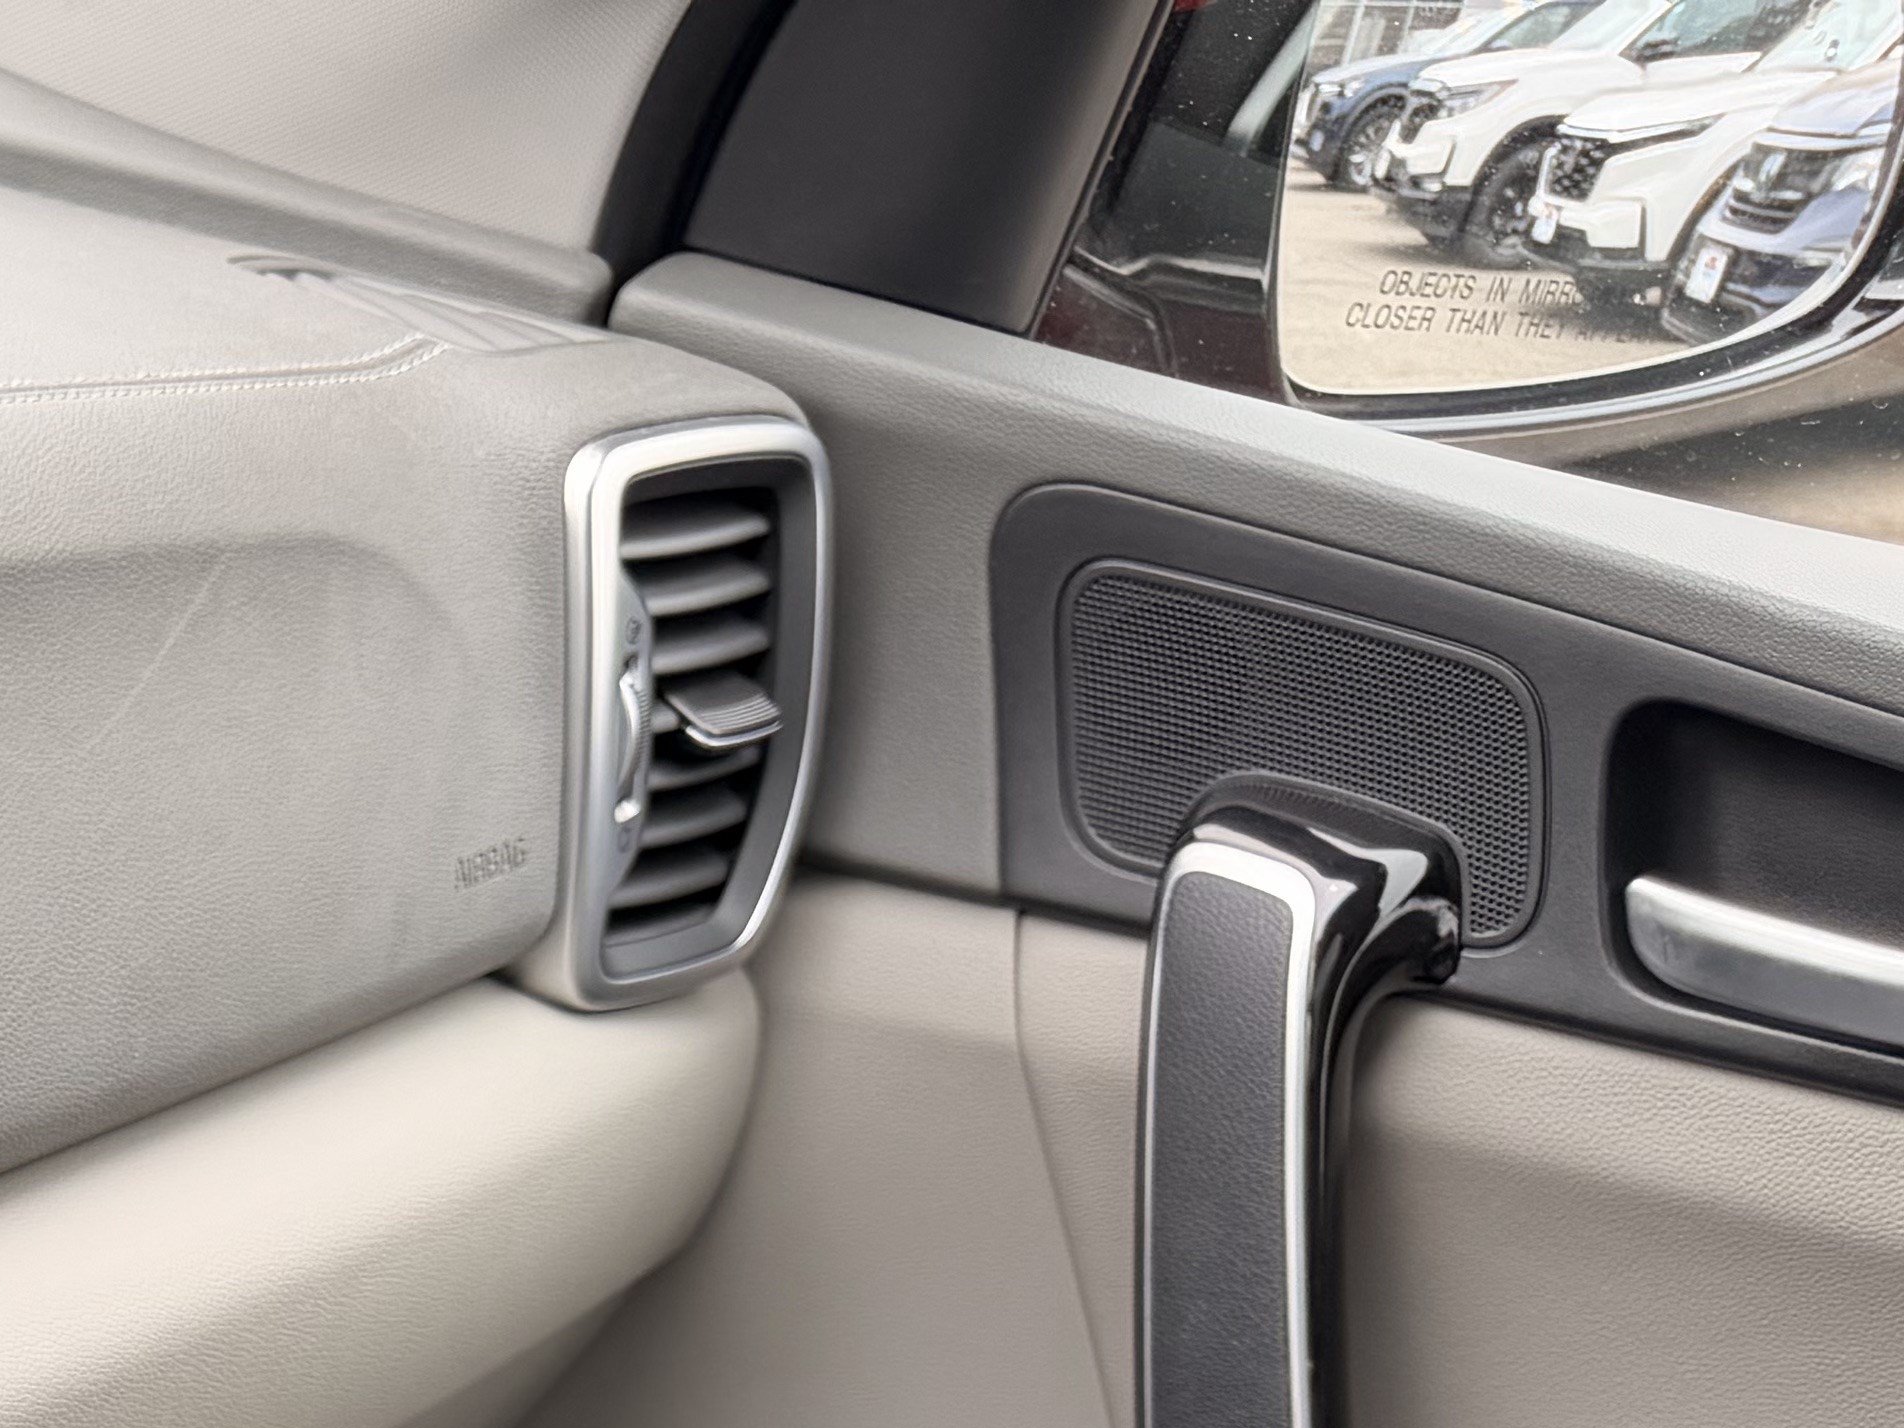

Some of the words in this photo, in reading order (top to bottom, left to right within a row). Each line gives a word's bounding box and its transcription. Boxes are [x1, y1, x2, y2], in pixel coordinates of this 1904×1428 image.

[1380, 270, 1477, 301] OBJECTS
[1489, 276, 1513, 304] IN
[1345, 301, 1436, 333] CLOSER
[1447, 307, 1506, 337] THAN
